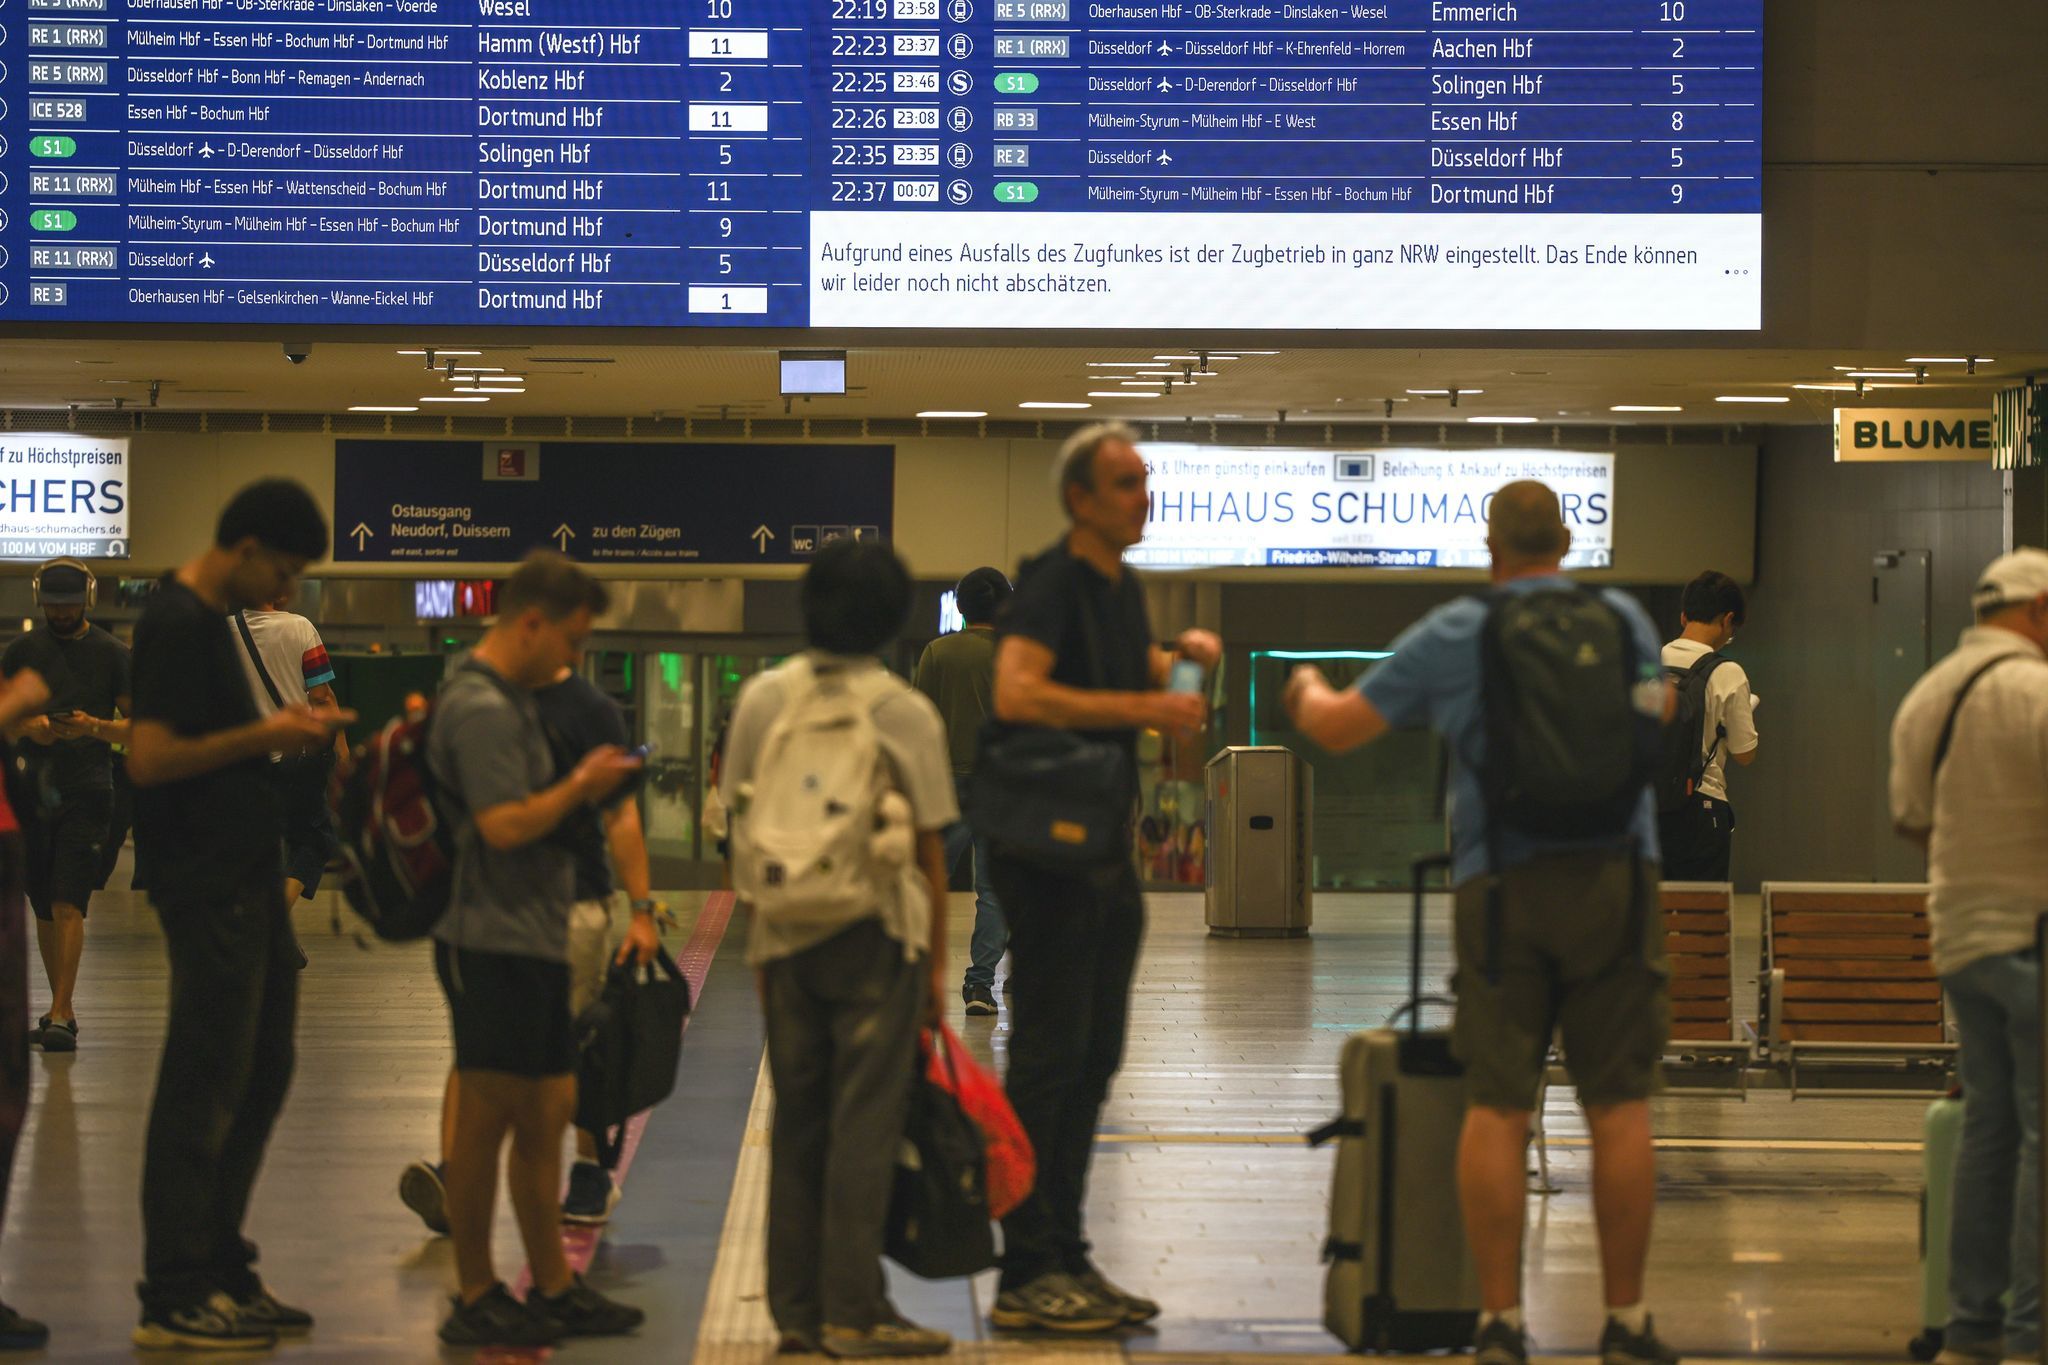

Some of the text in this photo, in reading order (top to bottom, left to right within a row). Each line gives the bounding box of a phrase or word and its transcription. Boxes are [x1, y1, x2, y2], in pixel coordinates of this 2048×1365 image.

[478, 0, 530, 16] Wesel
[708, 0, 732, 18] 10
[832, 0, 887, 19] 22:19
[898, 2, 935, 15] 23:58
[1432, 1, 1517, 21] Emmerich
[1660, 2, 1684, 21] 10
[32, 28, 103, 46] RE 1 (RRX)
[479, 31, 640, 57] Hamm (Westf) Hbf
[712, 38, 732, 54] 11
[832, 36, 887, 56] 22:23
[898, 38, 935, 52] 23:37
[997, 40, 1066, 56] RE 1 (RRX)
[1432, 38, 1533, 58] Aachen Hbf
[1672, 38, 1684, 58] 2
[32, 65, 104, 83] RE 5 (RRX)
[479, 69, 584, 90] Koblenz Hbf
[720, 72, 732, 92] 2
[832, 72, 886, 92] 22:25
[898, 74, 935, 88] 23:46
[1088, 76, 1358, 92] Düsseldorf D-Derendorf Düsseldorf Hbf
[1432, 74, 1542, 99] Solingen Hbf
[1672, 74, 1684, 94] 5
[33, 102, 82, 118] ICE 528
[128, 104, 270, 121] Essen Hbf Bochum Hbf
[479, 106, 603, 127] Dortmund Hbf
[712, 111, 732, 128] 11
[832, 108, 886, 128] 22:26
[898, 111, 935, 124] 23:08
[997, 112, 1034, 127] RB 33
[1432, 111, 1518, 131] Essen Hbf
[1672, 111, 1683, 131] 8
[128, 141, 404, 159] Düsseldorf D-Derendorf Düsseldorf Hbf
[479, 142, 590, 168] Solingen Hbf
[720, 144, 732, 164] 5
[832, 145, 886, 165] 22:35
[898, 148, 935, 161] 23:35
[997, 149, 1025, 163] RE 2
[1088, 149, 1152, 164] Düsseldorf
[1432, 147, 1563, 167] Düsseldorf Hbf
[1672, 148, 1683, 167] 5
[479, 179, 603, 200] Dortmund Hbf
[832, 182, 886, 202] 22:37
[898, 184, 935, 197] 00:07
[1431, 184, 1554, 204] Dortmund Hbf
[1671, 184, 1682, 204] 9
[128, 252, 194, 266] Düsseldorf
[479, 252, 611, 273] Düsseldorf Hbf
[720, 254, 731, 274] 5
[821, 242, 1697, 268] Aufgrund eines Ausfalls des Zugfunkes ist der Zugbetrieb in ganz NRW eingestellt. Das Ende können
[821, 272, 1111, 292] wir leider noch nicht abschätzen.
[34, 287, 63, 302] RE 3
[479, 288, 603, 309] Dortmund Hbf
[722, 293, 732, 310] 1
[8, 450, 23, 463] zu
[28, 447, 122, 468] Höchstpreisen
[1174, 460, 1210, 475] Uhren
[1264, 461, 1326, 476] einkaufen
[1383, 461, 1442, 480] Beleihung
[1460, 462, 1501, 477] Ankauf
[391, 503, 472, 521] Ostausgang
[390, 523, 511, 539] Neudorf, Duissern
[592, 523, 681, 540] zu den Zügen
[2, 542, 23, 554] 100
[38, 543, 66, 554] VOM
[70, 543, 97, 554] HBF
[793, 538, 814, 551] WC
